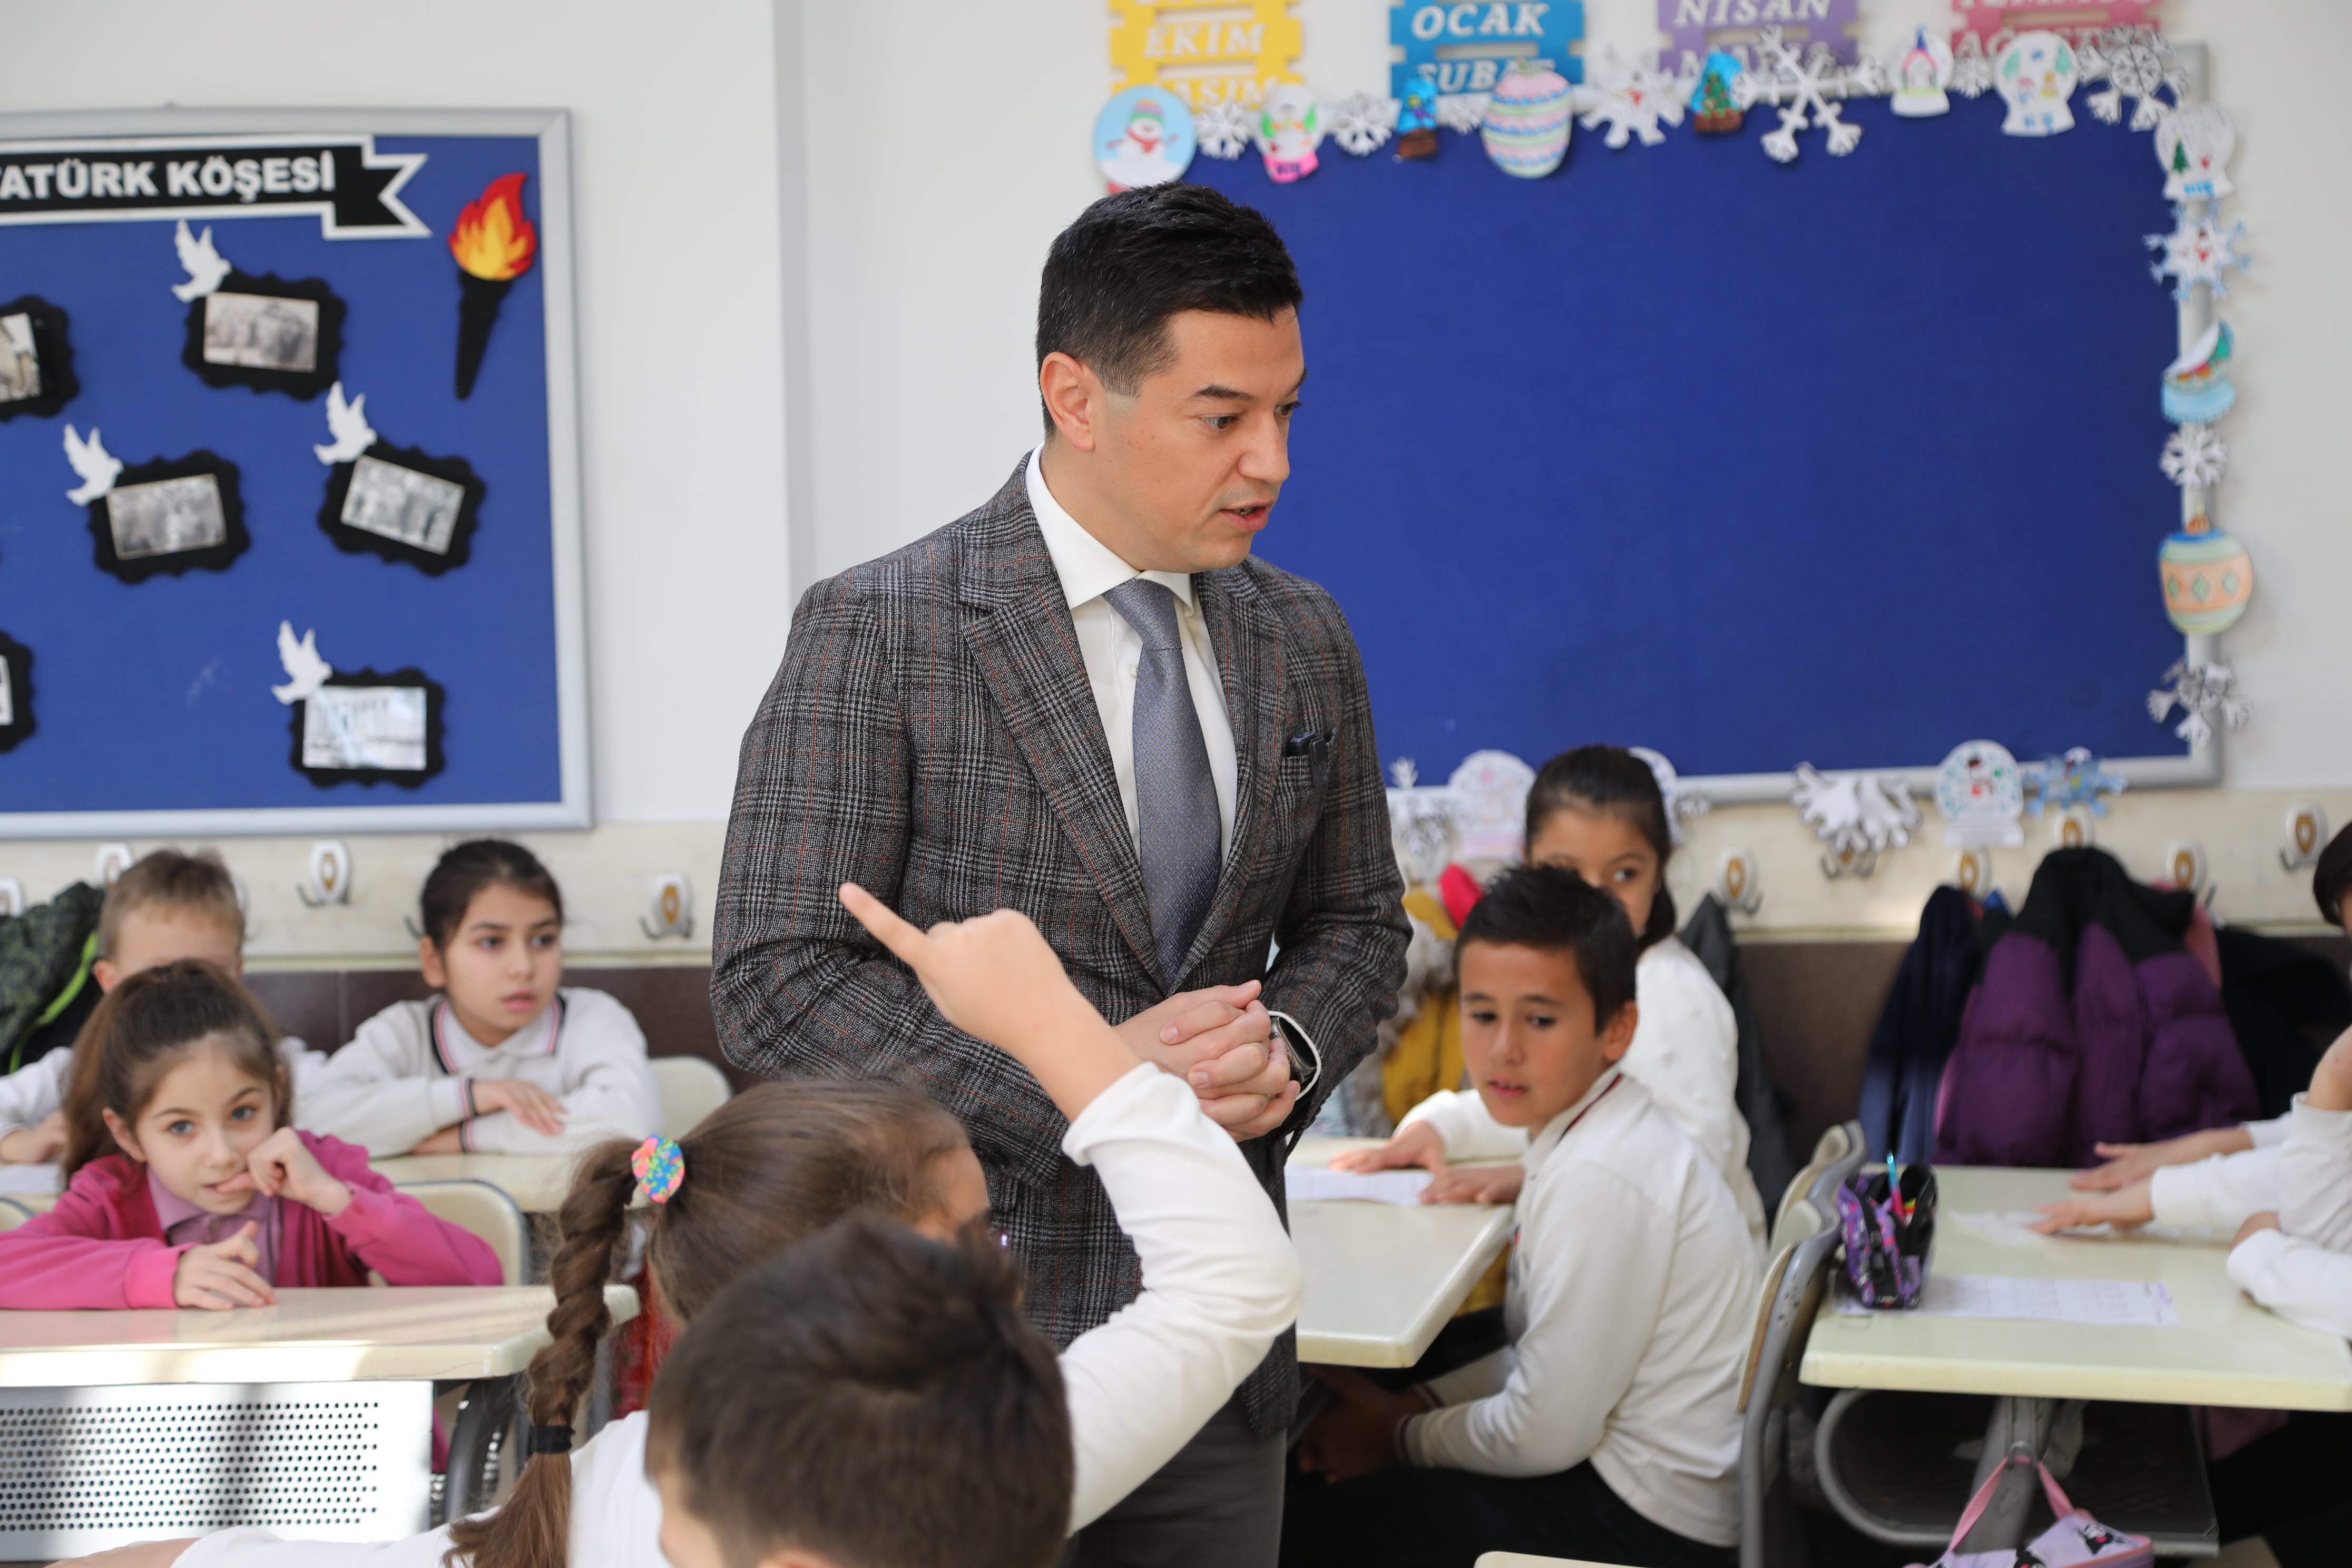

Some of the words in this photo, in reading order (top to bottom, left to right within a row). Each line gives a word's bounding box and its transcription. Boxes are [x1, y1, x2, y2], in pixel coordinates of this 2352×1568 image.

[1410, 2, 1550, 40] OCAK
[0, 158, 160, 200] ATÜRK
[166, 150, 337, 203] KÖŞESİ
